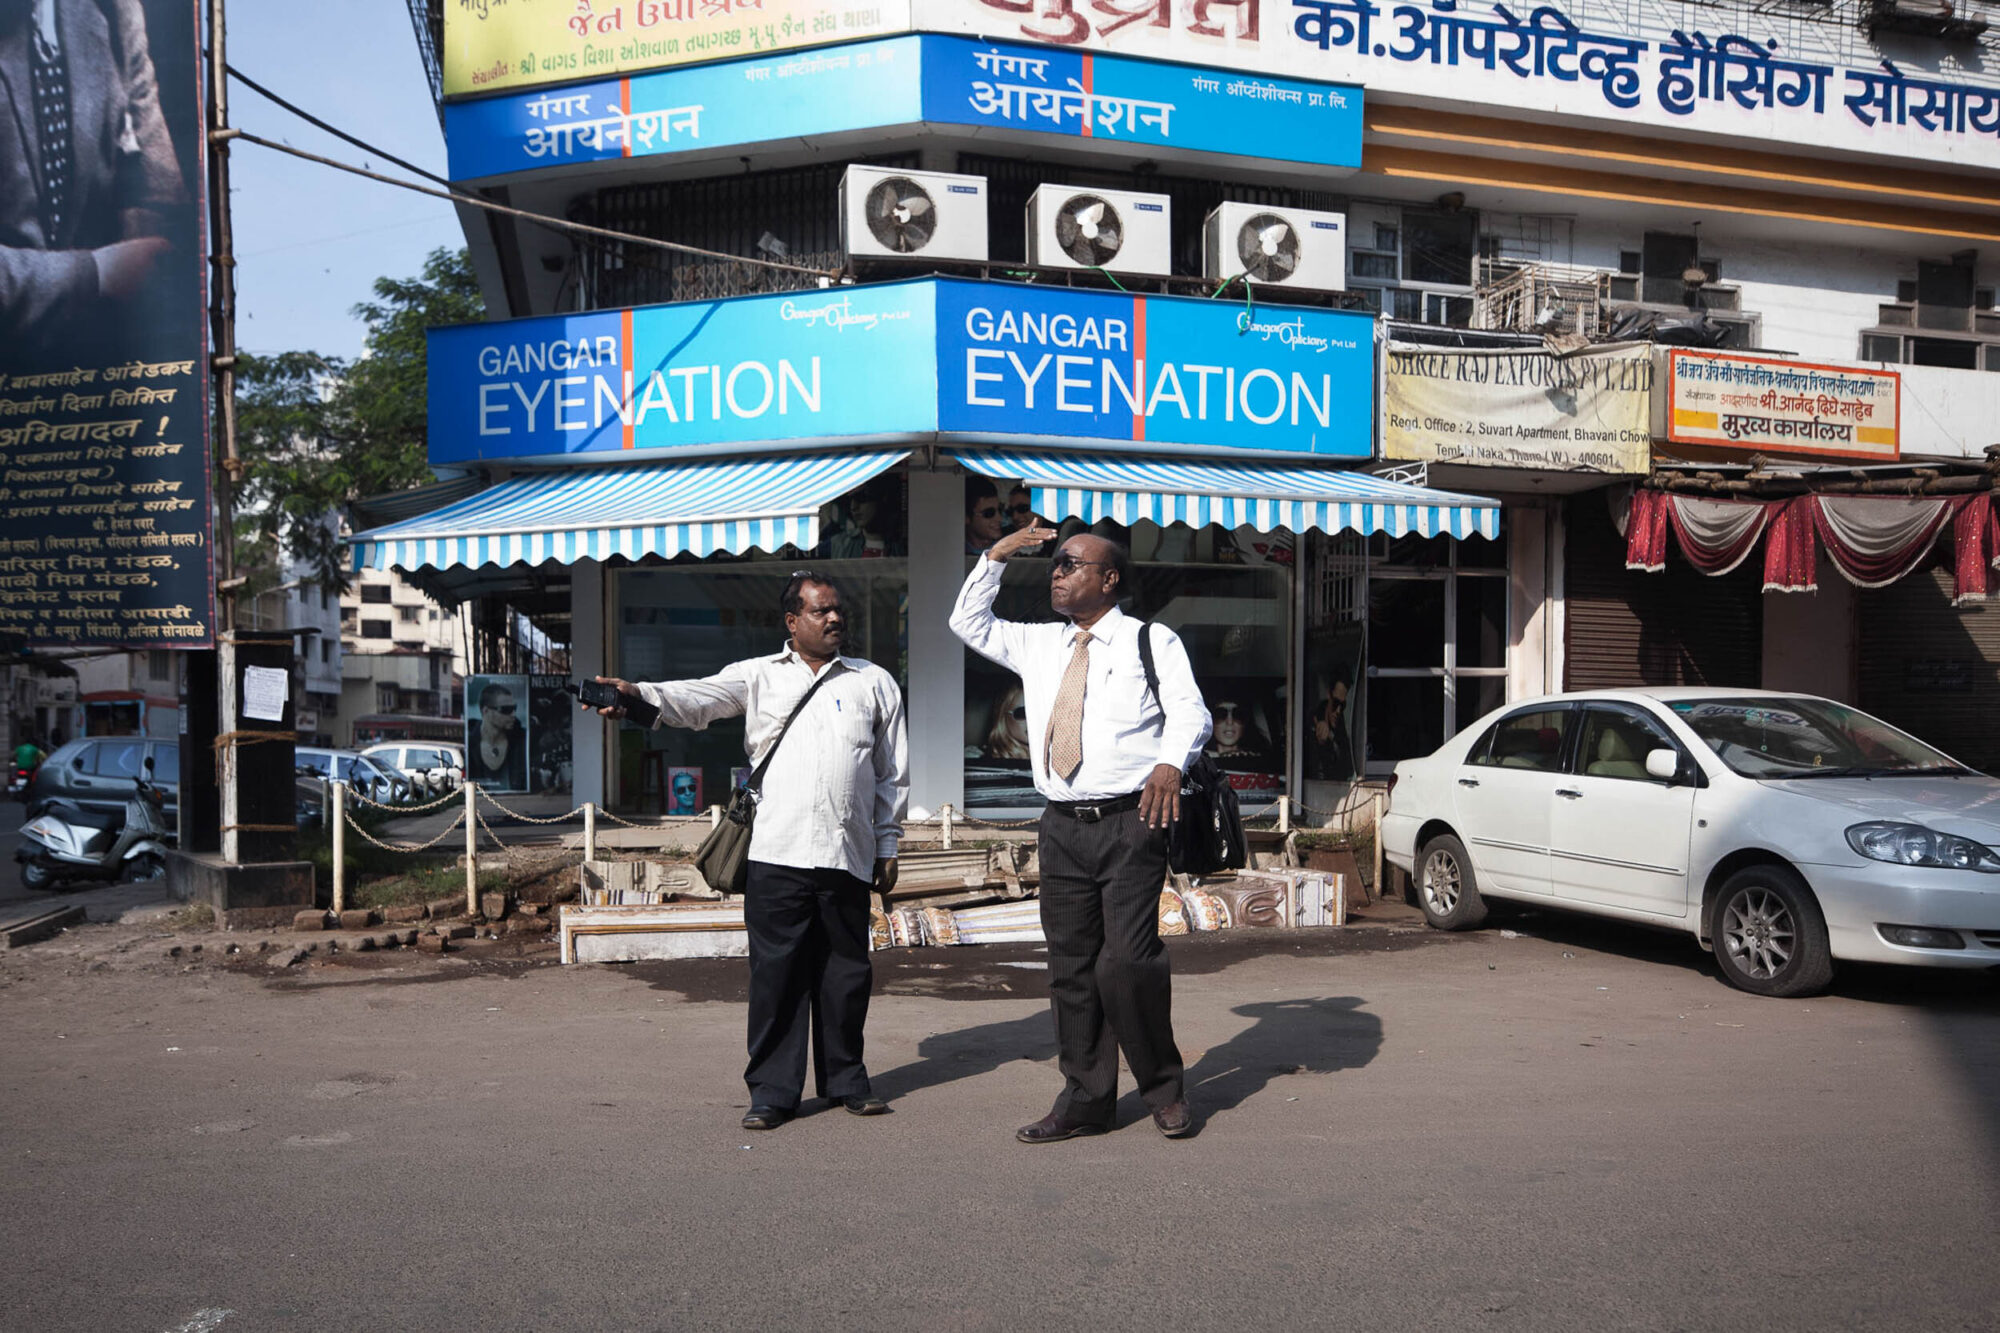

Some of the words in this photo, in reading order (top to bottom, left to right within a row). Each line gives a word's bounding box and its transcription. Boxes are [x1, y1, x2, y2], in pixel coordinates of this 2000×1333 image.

[973, 47, 1050, 83] गंगर
[1658, 29, 1833, 115] हौसिंग
[1191, 75, 1220, 95] गंगर
[525, 94, 591, 121] गंगर
[967, 77, 1176, 138] आयनेशन
[522, 102, 703, 159] आयनेशन
[965, 307, 1128, 352] GANGAR
[102, 360, 196, 382] आंबेडकर
[477, 335, 617, 377] GANGAR
[1390, 353, 1450, 379] SHREE
[1456, 354, 1489, 384] RAJ
[478, 356, 821, 436] EYENATION
[966, 348, 1331, 428] EYENATION
[1816, 394, 1839, 417] दिघे
[1839, 398, 1874, 421] साहेब
[1390, 414, 1421, 430] Regd.
[1424, 417, 1457, 433] Office
[1478, 421, 1513, 437] Suvart
[1516, 425, 1572, 443] Apartment,
[1574, 428, 1617, 442] Bhavani
[1774, 415, 1853, 442] कार्यालय
[131, 441, 184, 457] साहेब
[130, 479, 183, 495] साहेब
[143, 496, 196, 512] साहेब
